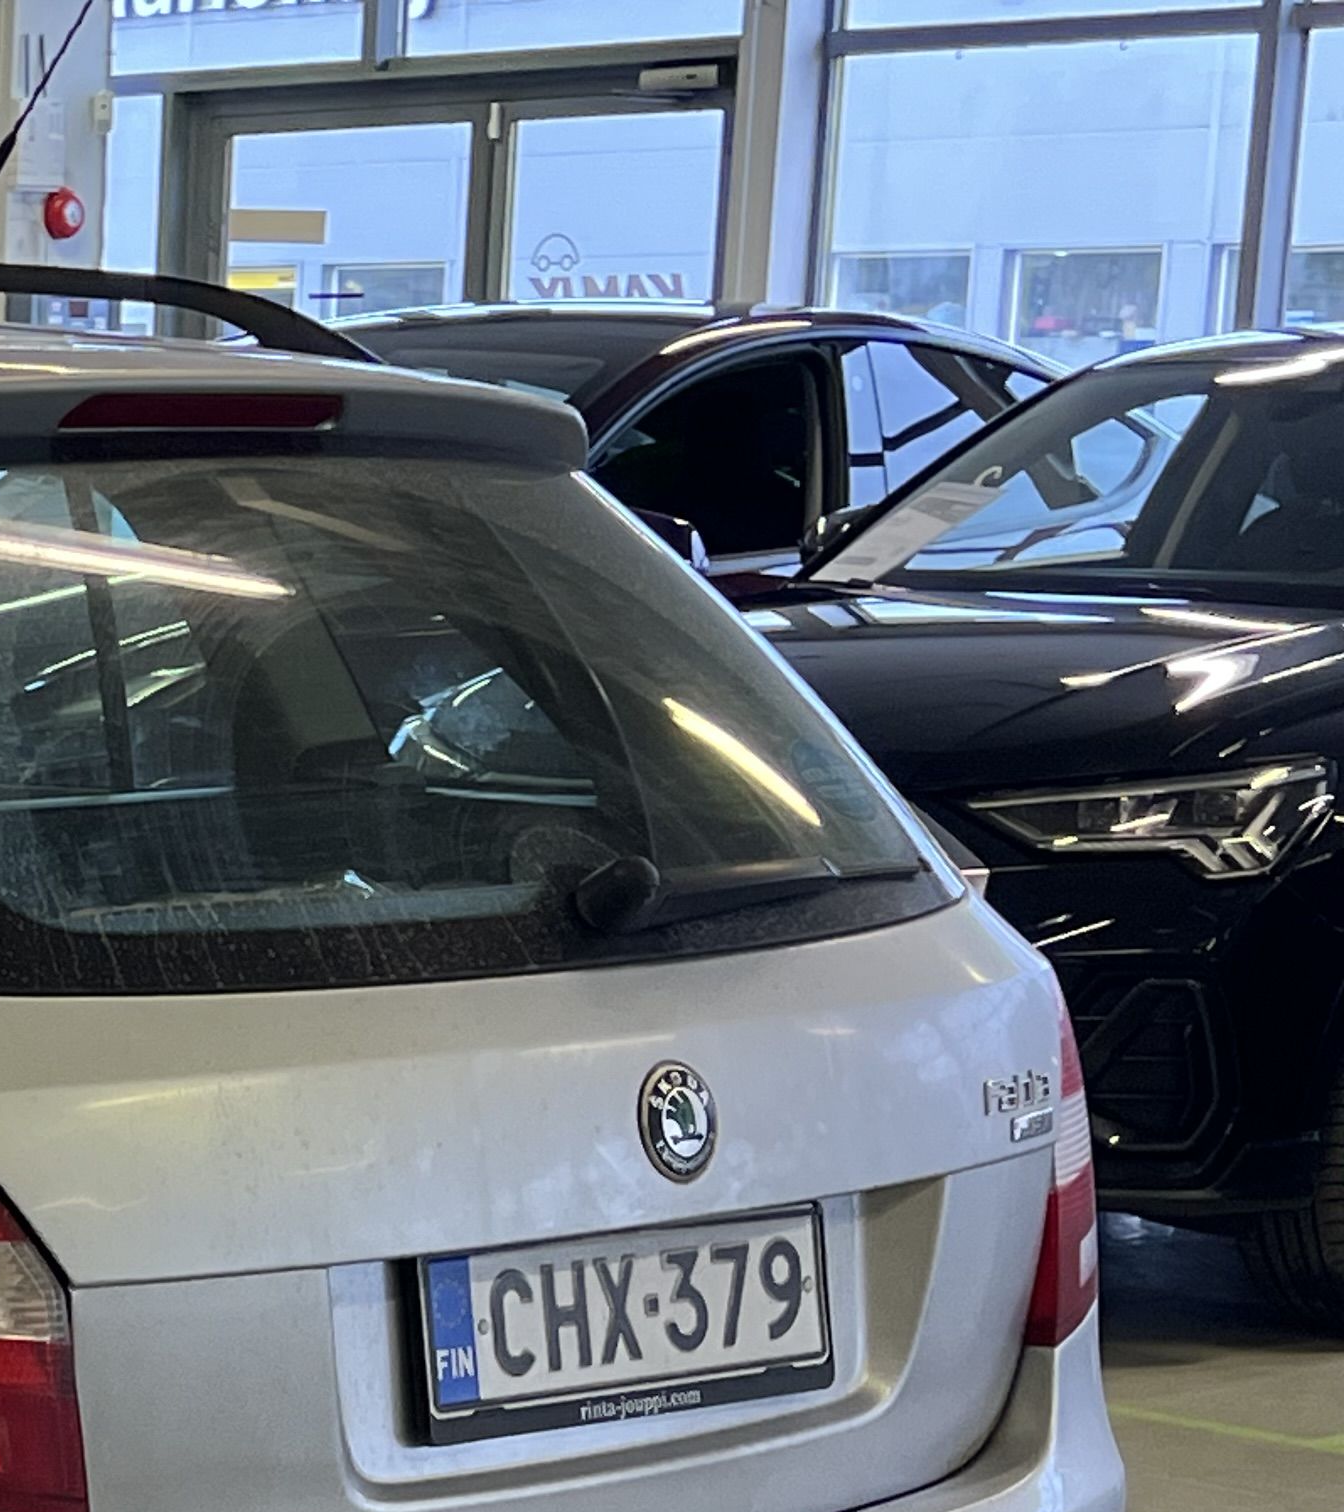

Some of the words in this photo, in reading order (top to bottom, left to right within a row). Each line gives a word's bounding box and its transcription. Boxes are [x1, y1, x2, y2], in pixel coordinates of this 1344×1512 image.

[489, 1236, 802, 1377] CHX-379
[436, 1346, 475, 1381] FIN
[580, 1389, 701, 1420] rinta-jouppi.com
